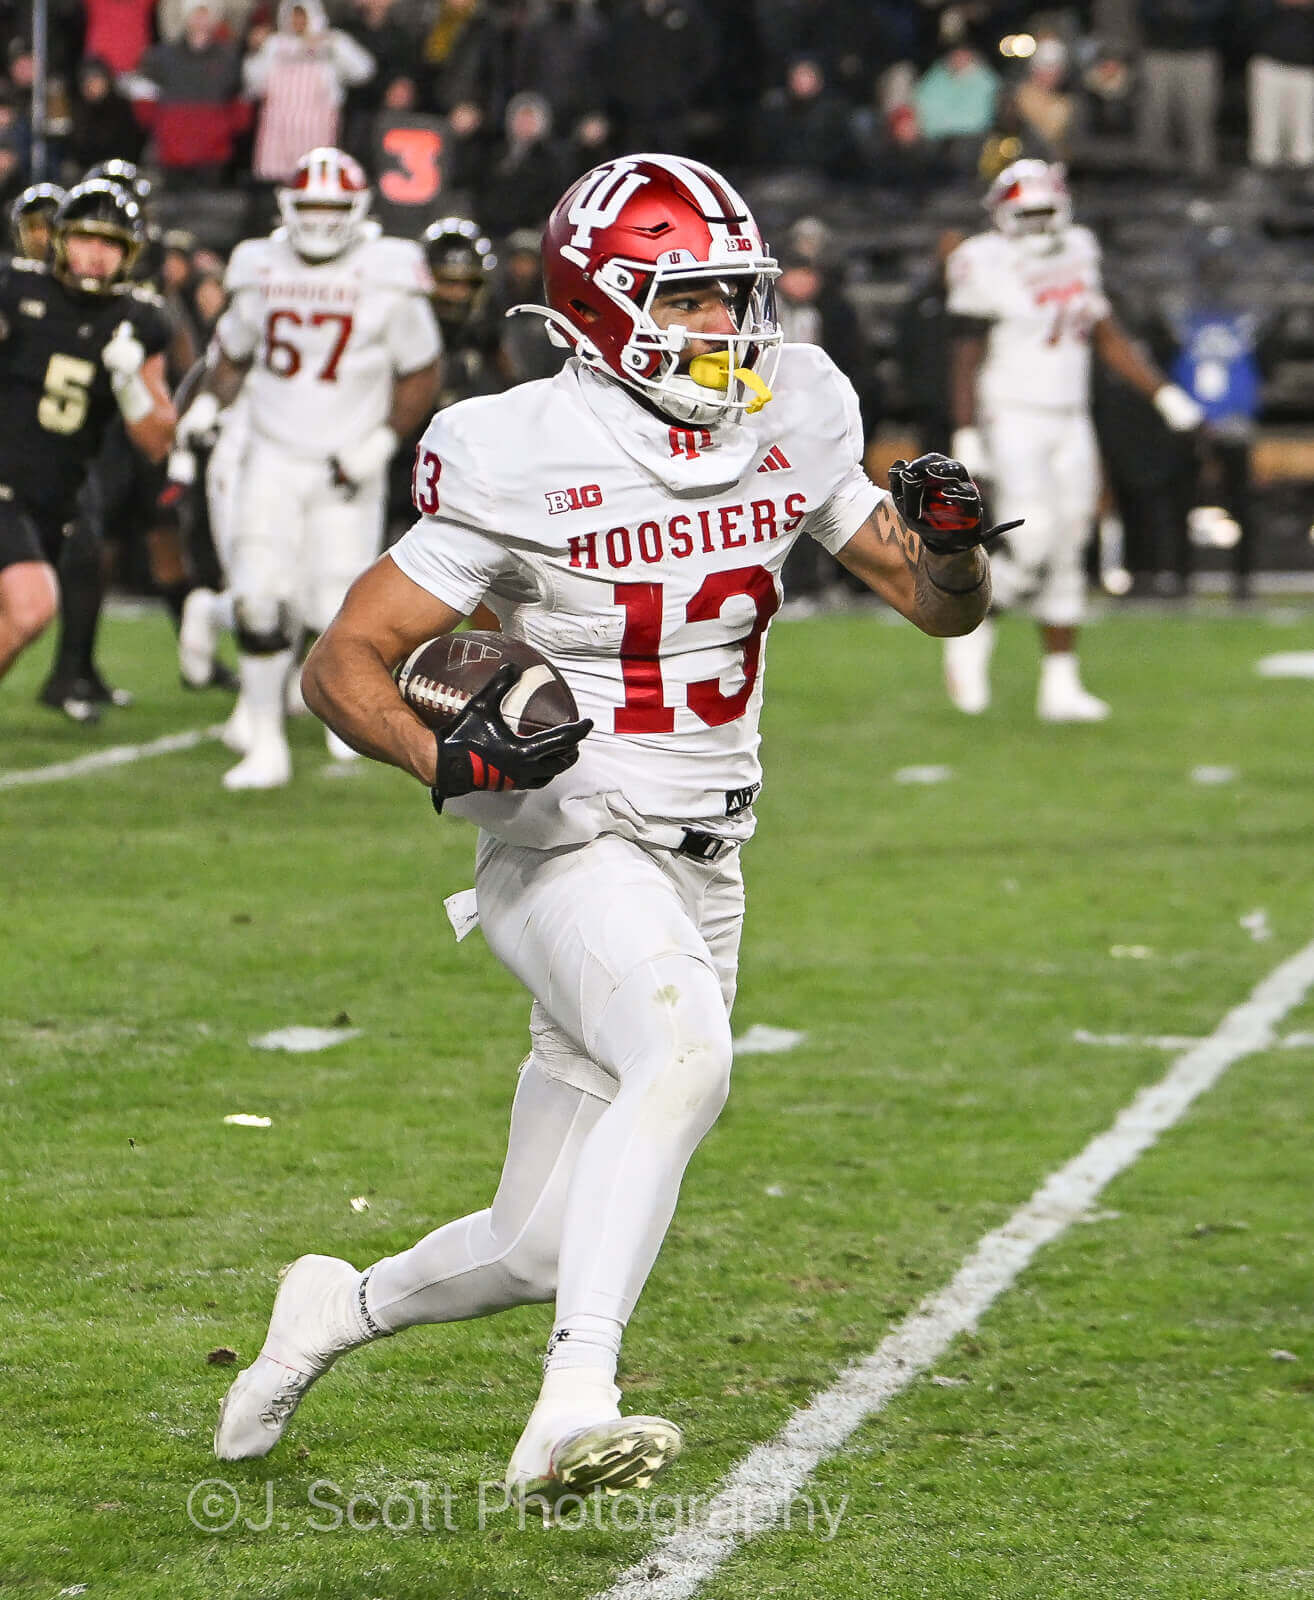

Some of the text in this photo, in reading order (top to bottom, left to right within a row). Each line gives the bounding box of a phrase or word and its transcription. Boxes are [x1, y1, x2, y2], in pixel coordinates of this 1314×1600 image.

[380, 129, 442, 204] 3
[265, 309, 354, 383] 67
[37, 352, 96, 435] 5
[567, 493, 807, 569] HOOSIERS
[613, 565, 779, 734] 13
